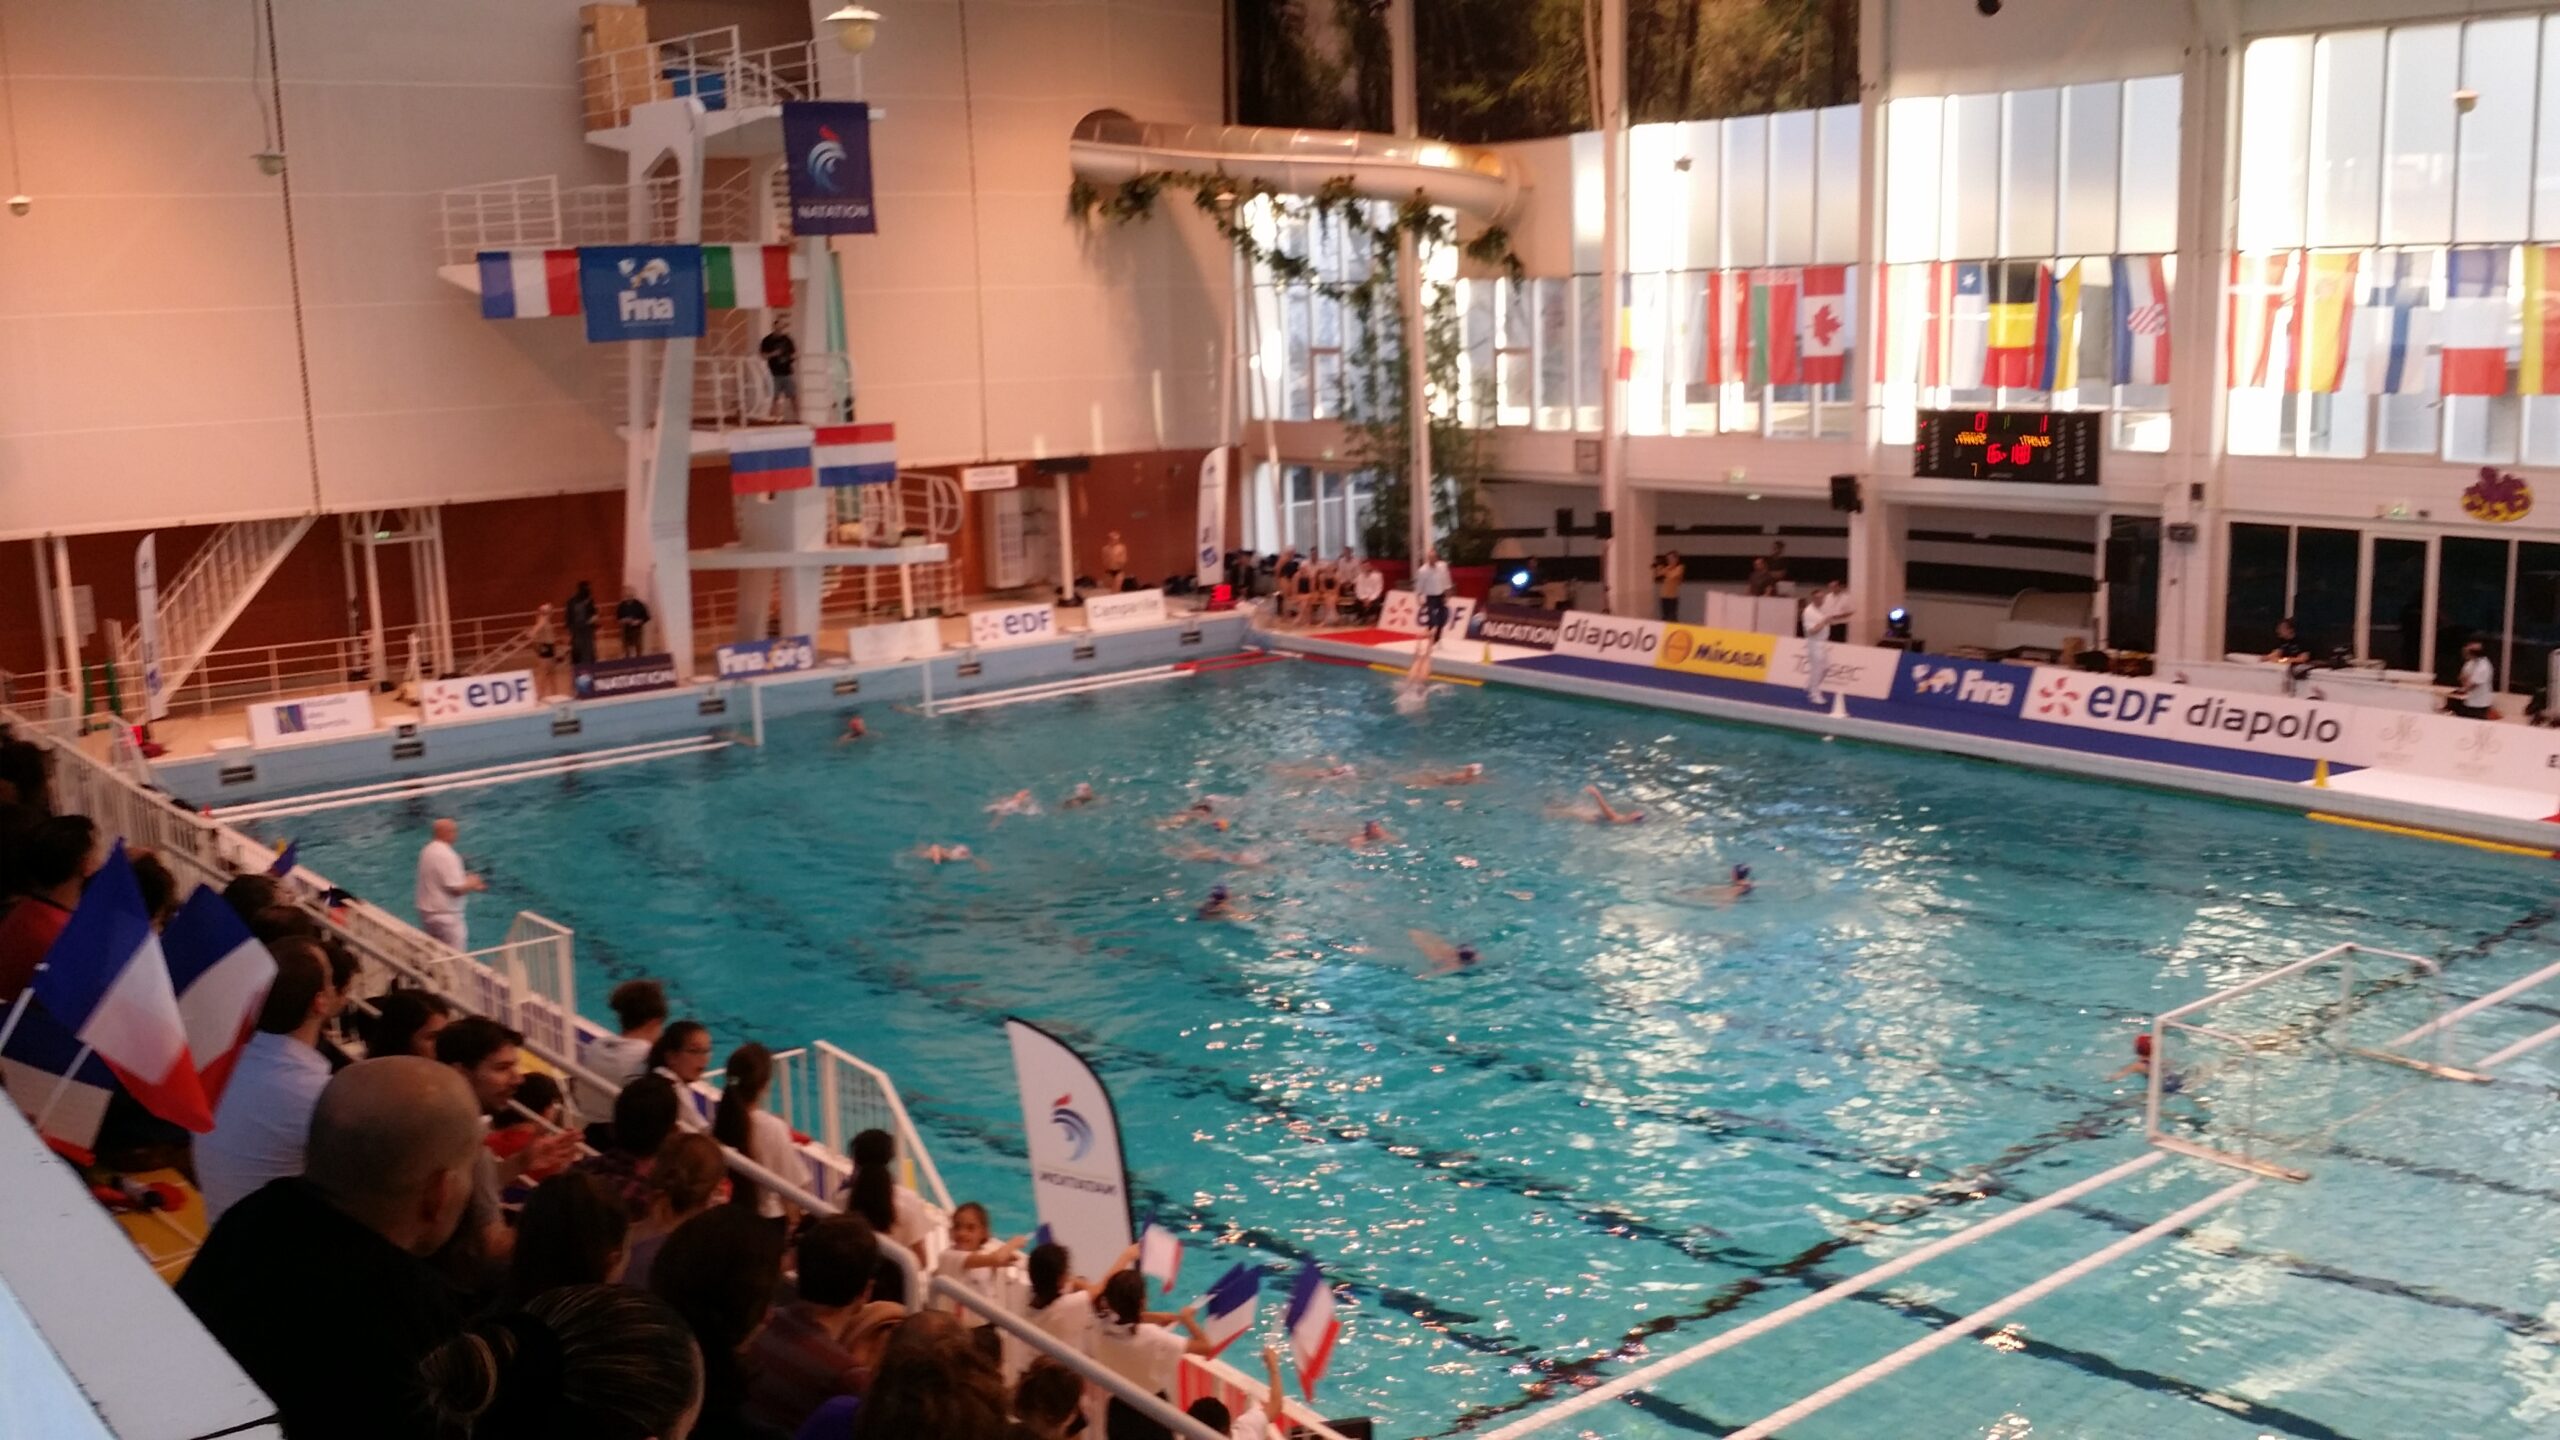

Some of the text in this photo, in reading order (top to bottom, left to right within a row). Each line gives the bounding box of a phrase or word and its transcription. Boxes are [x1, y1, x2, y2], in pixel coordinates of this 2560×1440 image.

[797, 204, 869, 218] NATATION
[617, 291, 674, 321] Fina
[1480, 621, 1559, 644] NATATION
[1563, 618, 1658, 653] diapolo
[592, 671, 677, 691] NATATION
[1957, 668, 2014, 707] Fina
[2186, 697, 2342, 744] diapolo
